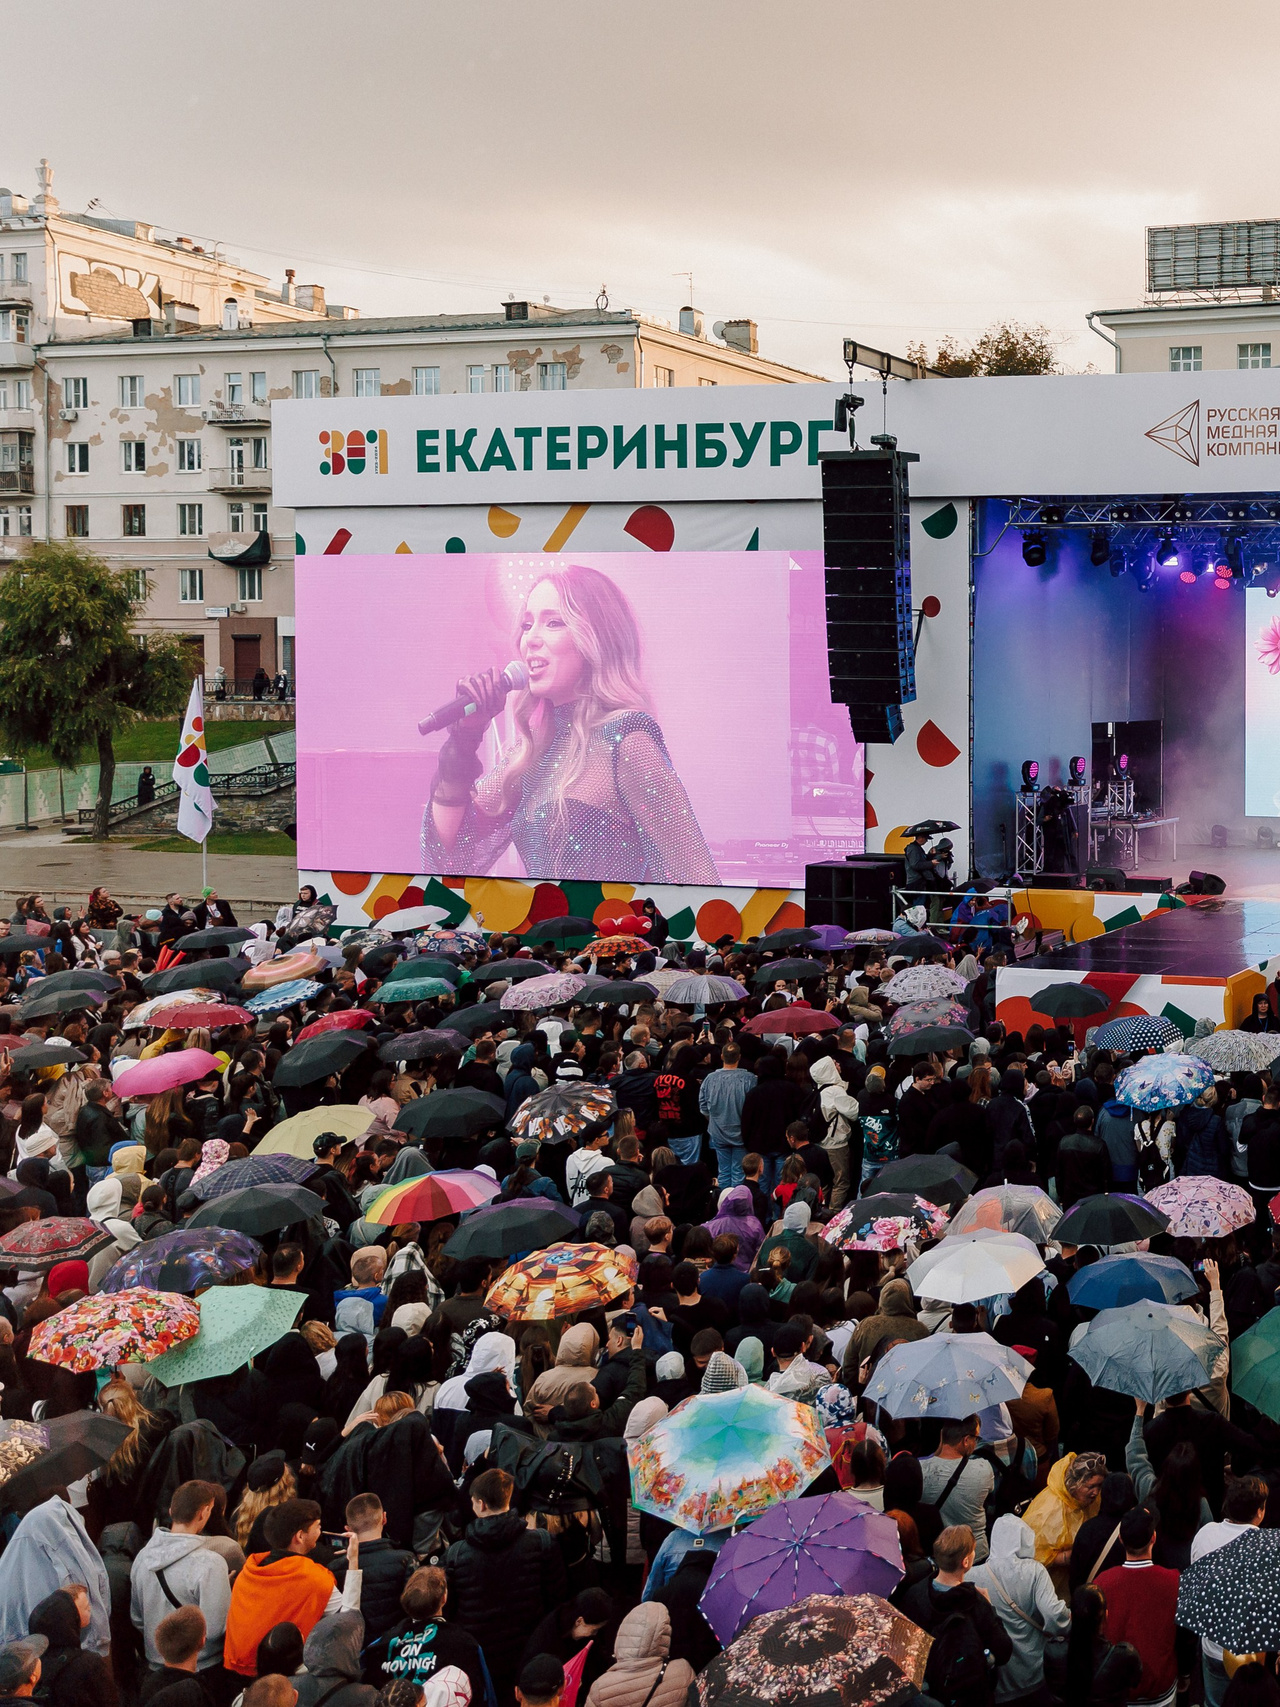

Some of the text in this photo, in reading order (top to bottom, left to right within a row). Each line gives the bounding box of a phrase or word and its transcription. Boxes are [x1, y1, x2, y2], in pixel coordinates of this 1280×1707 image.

[1206, 407, 1280, 422] РУССКАЯ
[1206, 424, 1278, 440] МЕДНАЯ
[416, 420, 835, 473] ЕКАТЕРИНБУРГ
[400, 1643, 423, 1658] ON
[381, 1655, 437, 1673] MOVING!
